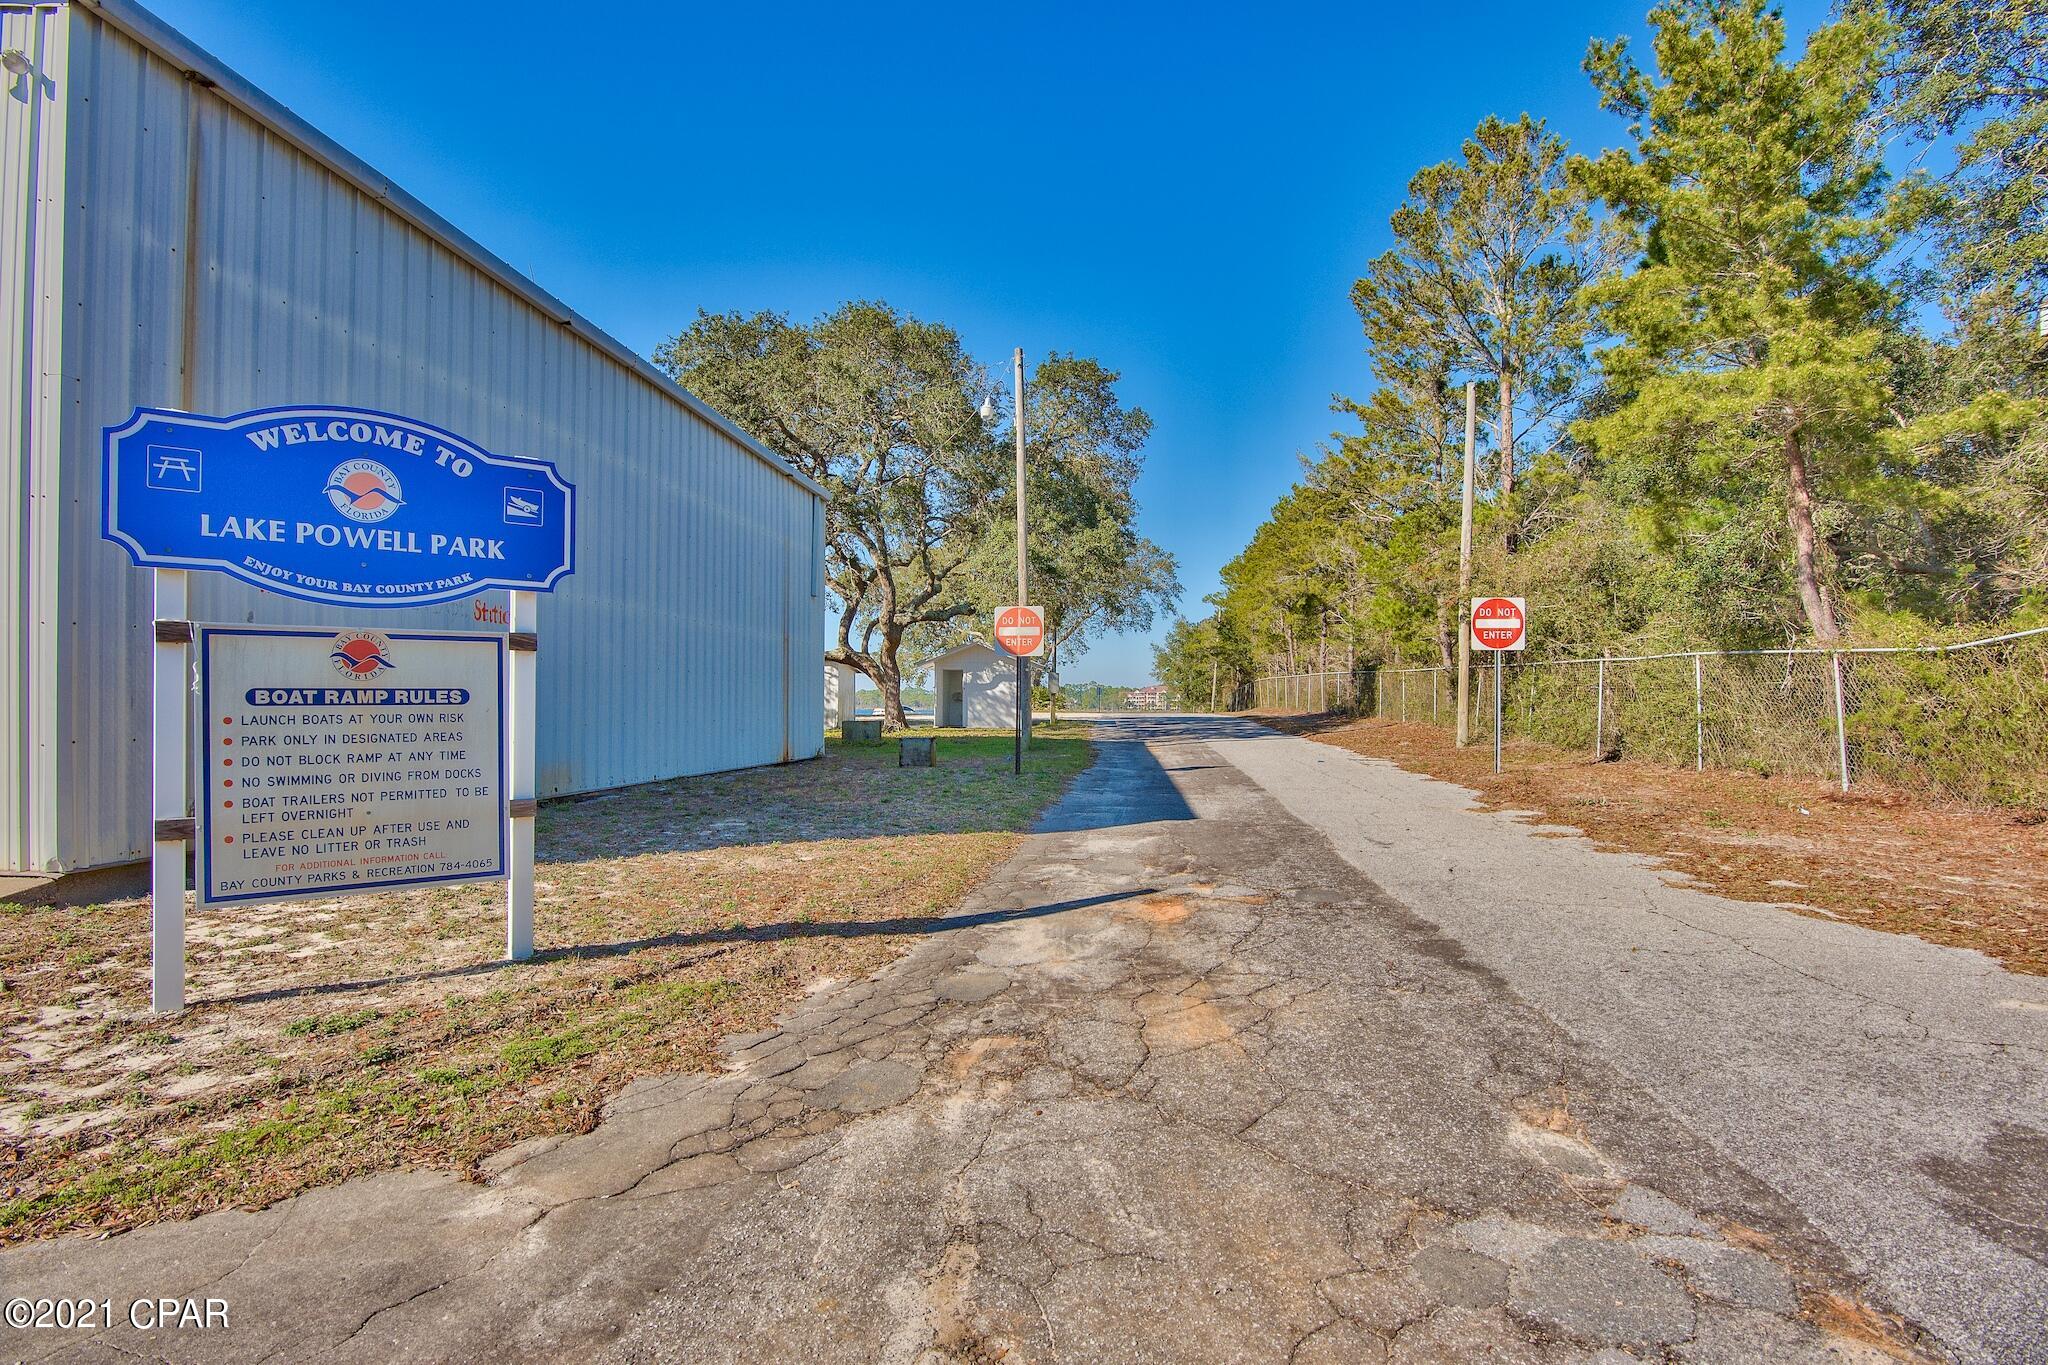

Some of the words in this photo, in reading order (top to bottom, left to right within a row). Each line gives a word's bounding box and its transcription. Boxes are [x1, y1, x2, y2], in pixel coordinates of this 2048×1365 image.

[246, 421, 425, 456] WELCOME
[435, 445, 474, 478] TO
[333, 465, 351, 484] BAY
[353, 462, 396, 489] COUNTY
[340, 503, 389, 520] FLORIDA
[200, 514, 286, 543] LAKE
[296, 521, 422, 554] POWELL
[431, 534, 506, 560] PARK
[243, 555, 294, 581] ENJOY
[296, 573, 338, 592] YOUR
[342, 583, 372, 595] BAY
[375, 581, 434, 595] COUNTY
[436, 572, 474, 590] PARK
[1002, 616, 1014, 625] DO
[1020, 616, 1036, 625] NOT
[1479, 607, 1492, 617] DO
[1497, 607, 1516, 617] NOT
[1005, 638, 1033, 646] ENTER
[1483, 630, 1513, 640] ENTER
[254, 689, 318, 705] BOAT
[324, 690, 388, 705] RAMP
[394, 690, 462, 704] RULES
[241, 715, 296, 726] LAUNCH
[302, 714, 343, 725] BOATS
[348, 714, 364, 724] AT
[370, 713, 403, 724] YOUR
[408, 713, 434, 723] OWN
[439, 713, 465, 723] RISK
[241, 735, 276, 746] PARK
[283, 734, 318, 746] ONLY
[324, 734, 336, 745] IN
[342, 732, 418, 744] DESIGNATED
[423, 732, 463, 742] AREAS
[241, 756, 260, 767] DO
[266, 755, 292, 766] NOT
[298, 753, 341, 765] BLOCK
[347, 752, 383, 764] RAMP
[387, 752, 402, 762] AT
[408, 751, 433, 762] ANY
[440, 750, 466, 760] TIME
[242, 777, 261, 788] NO
[267, 774, 332, 787] SWIMMING
[338, 773, 356, 784] OR
[361, 771, 402, 783] DIVING
[407, 770, 440, 781] FROM
[445, 768, 482, 779] DOCKS
[242, 797, 276, 809] BOAT
[282, 793, 345, 806] TRAILERS
[351, 791, 375, 803] NOT
[380, 788, 447, 801] PERMITTED
[456, 787, 470, 798] TO
[475, 786, 489, 797] BE
[242, 812, 275, 824] LEFT
[281, 807, 354, 822] OVERNIGHT
[242, 830, 295, 844] PLEASE
[301, 827, 344, 840] CLEAN
[350, 825, 367, 837] UP
[373, 822, 412, 835] AFTER
[418, 821, 441, 832] USE
[446, 819, 470, 830] AND
[243, 846, 286, 860] LEAVE
[292, 844, 309, 856] NO
[316, 841, 359, 854] LITTER
[364, 839, 381, 850] OR
[386, 836, 426, 848] TRASH
[275, 863, 296, 872] FOR
[300, 859, 356, 870] ADDITIONAL
[360, 853, 420, 866] INFORMATION
[220, 880, 246, 892] BAY
[251, 874, 302, 889] COUNTY
[307, 871, 347, 884] PARKS
[352, 870, 361, 880] &
[367, 863, 436, 878] RECREATION
[440, 858, 493, 871] 784-4065
